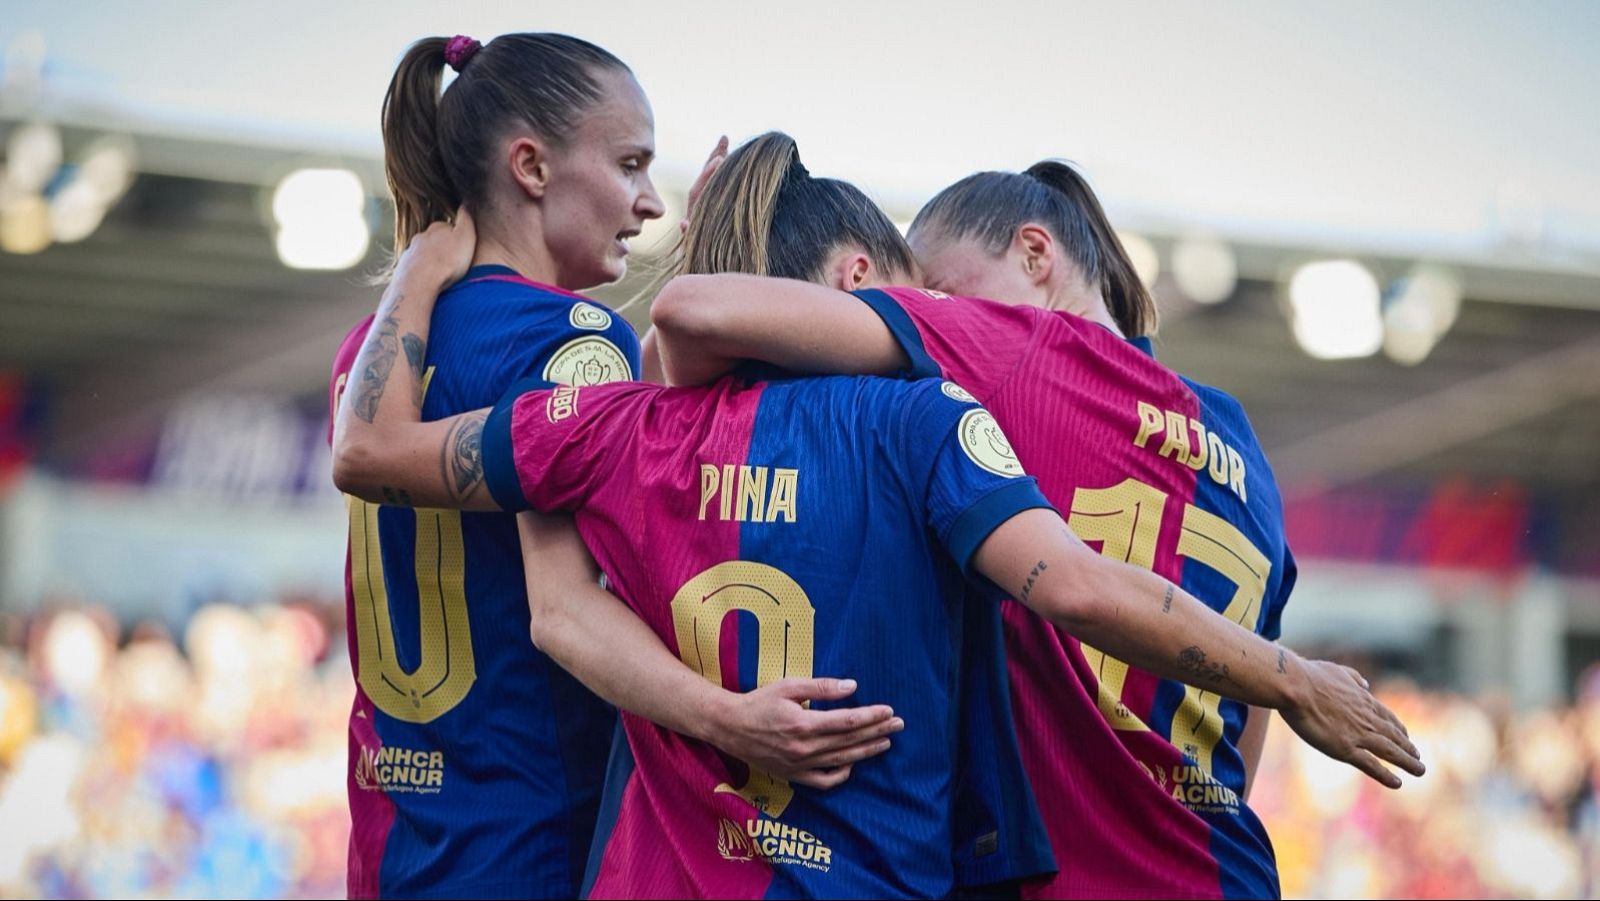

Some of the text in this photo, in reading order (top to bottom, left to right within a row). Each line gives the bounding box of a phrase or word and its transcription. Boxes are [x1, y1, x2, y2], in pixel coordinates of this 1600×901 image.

[580, 311, 601, 321] 10
[1132, 400, 1248, 504] PAJOR
[698, 464, 799, 523] PINA
[345, 492, 478, 724] 0
[1067, 477, 1272, 776] 17
[670, 560, 816, 819] 9
[747, 819, 823, 846] UNHC
[801, 860, 830, 873] Agency
